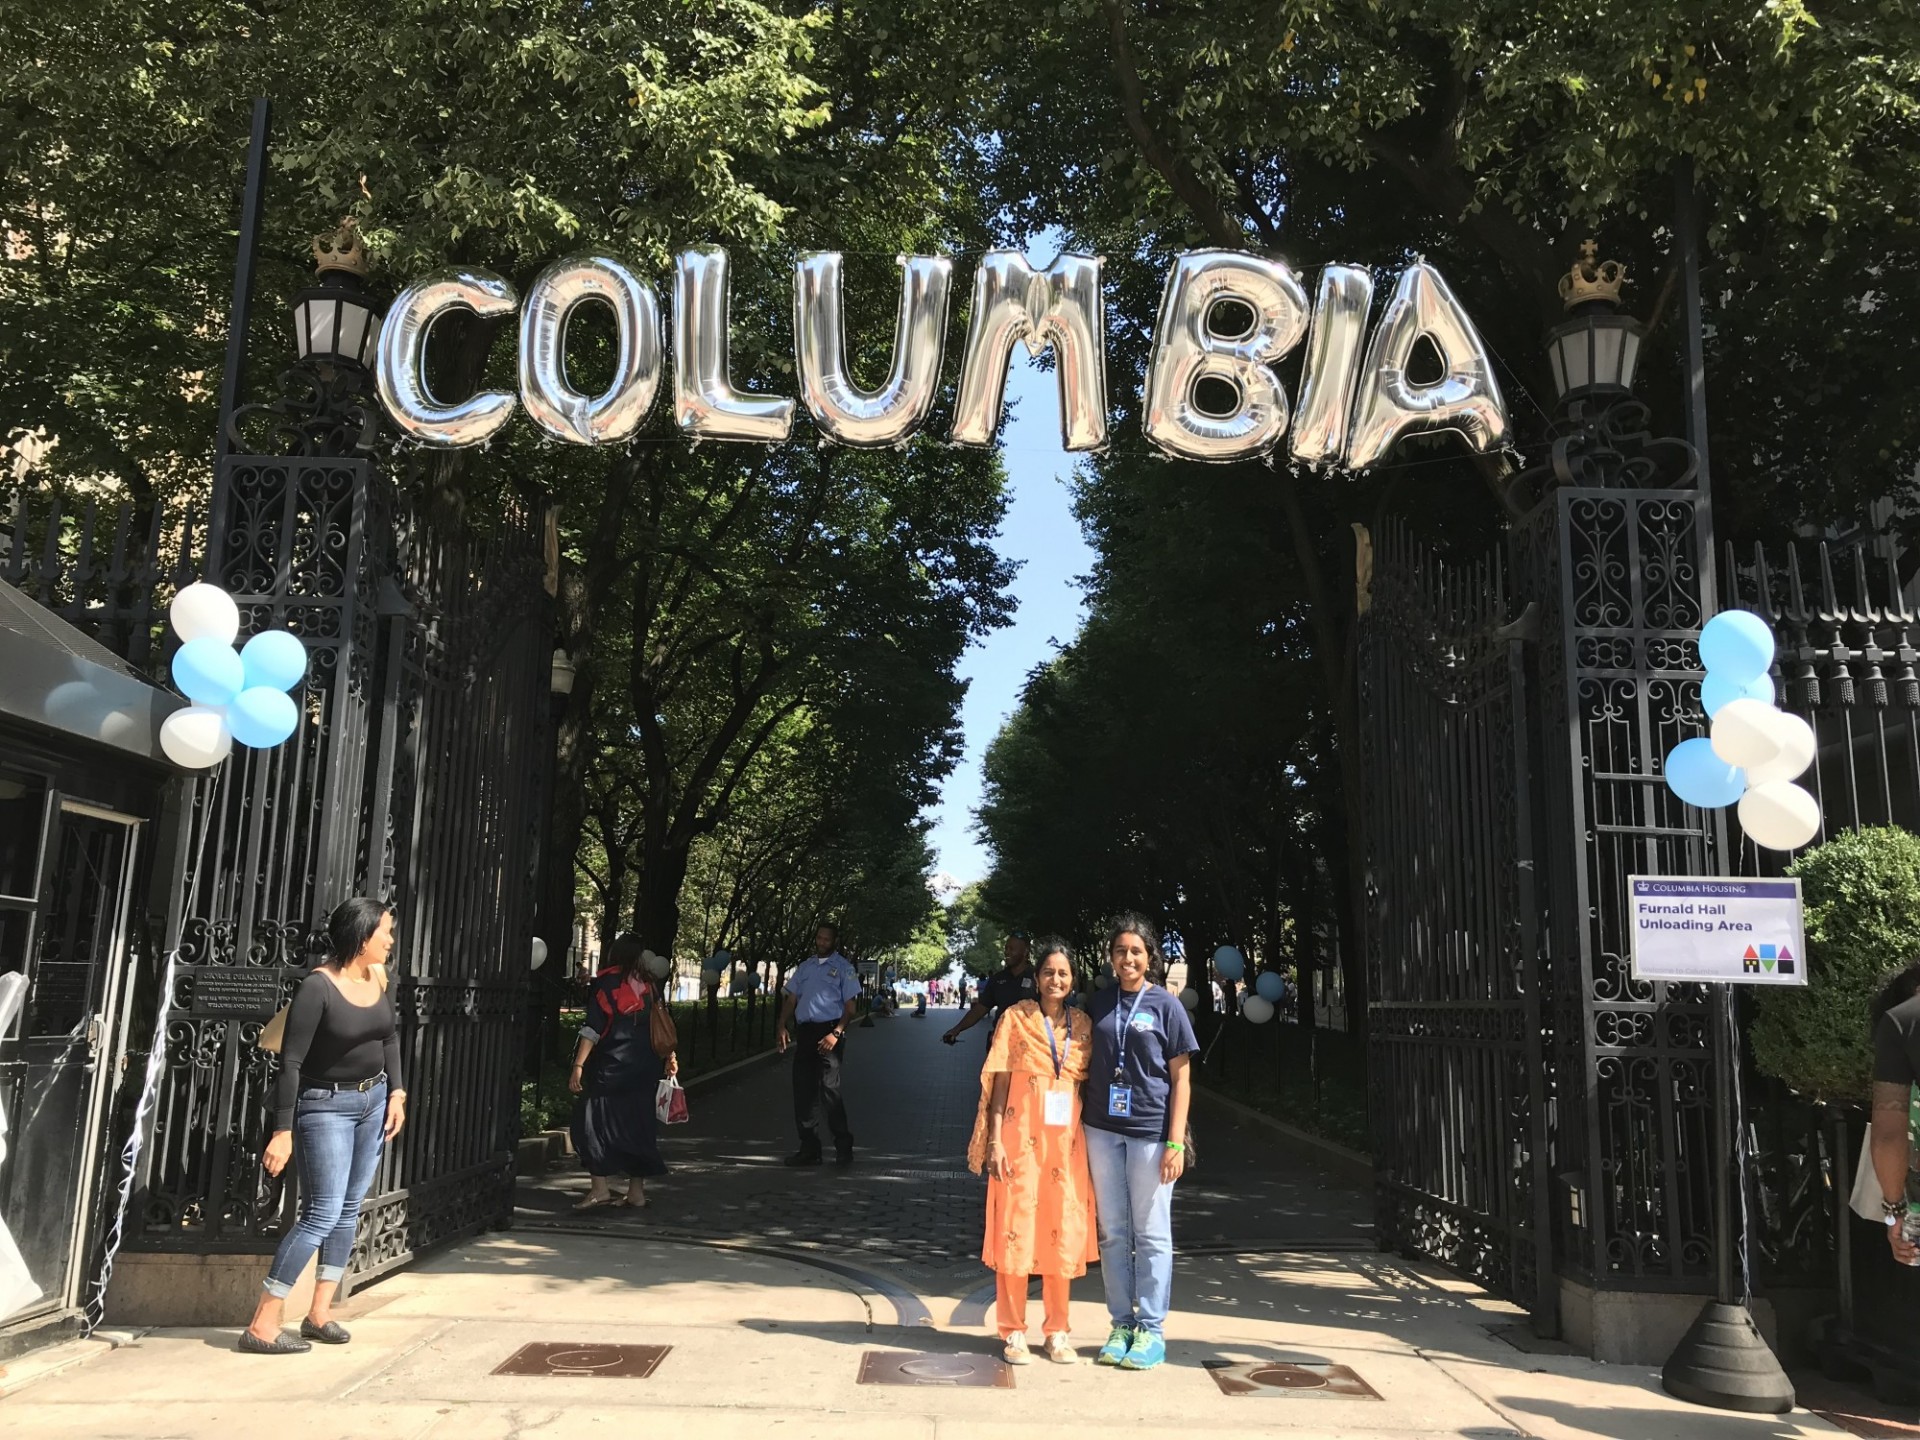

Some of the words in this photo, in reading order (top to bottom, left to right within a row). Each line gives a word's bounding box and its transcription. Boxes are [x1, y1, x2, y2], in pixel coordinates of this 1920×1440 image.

[376, 245, 1513, 470] COLUMBIA
[1653, 883, 1700, 892] COLUMBIA
[1702, 885, 1746, 893] HOUSING
[1639, 903, 1694, 914] Furnald
[1698, 904, 1726, 915] Hall
[1639, 919, 1713, 932] Unloading
[1718, 920, 1753, 931] Area
